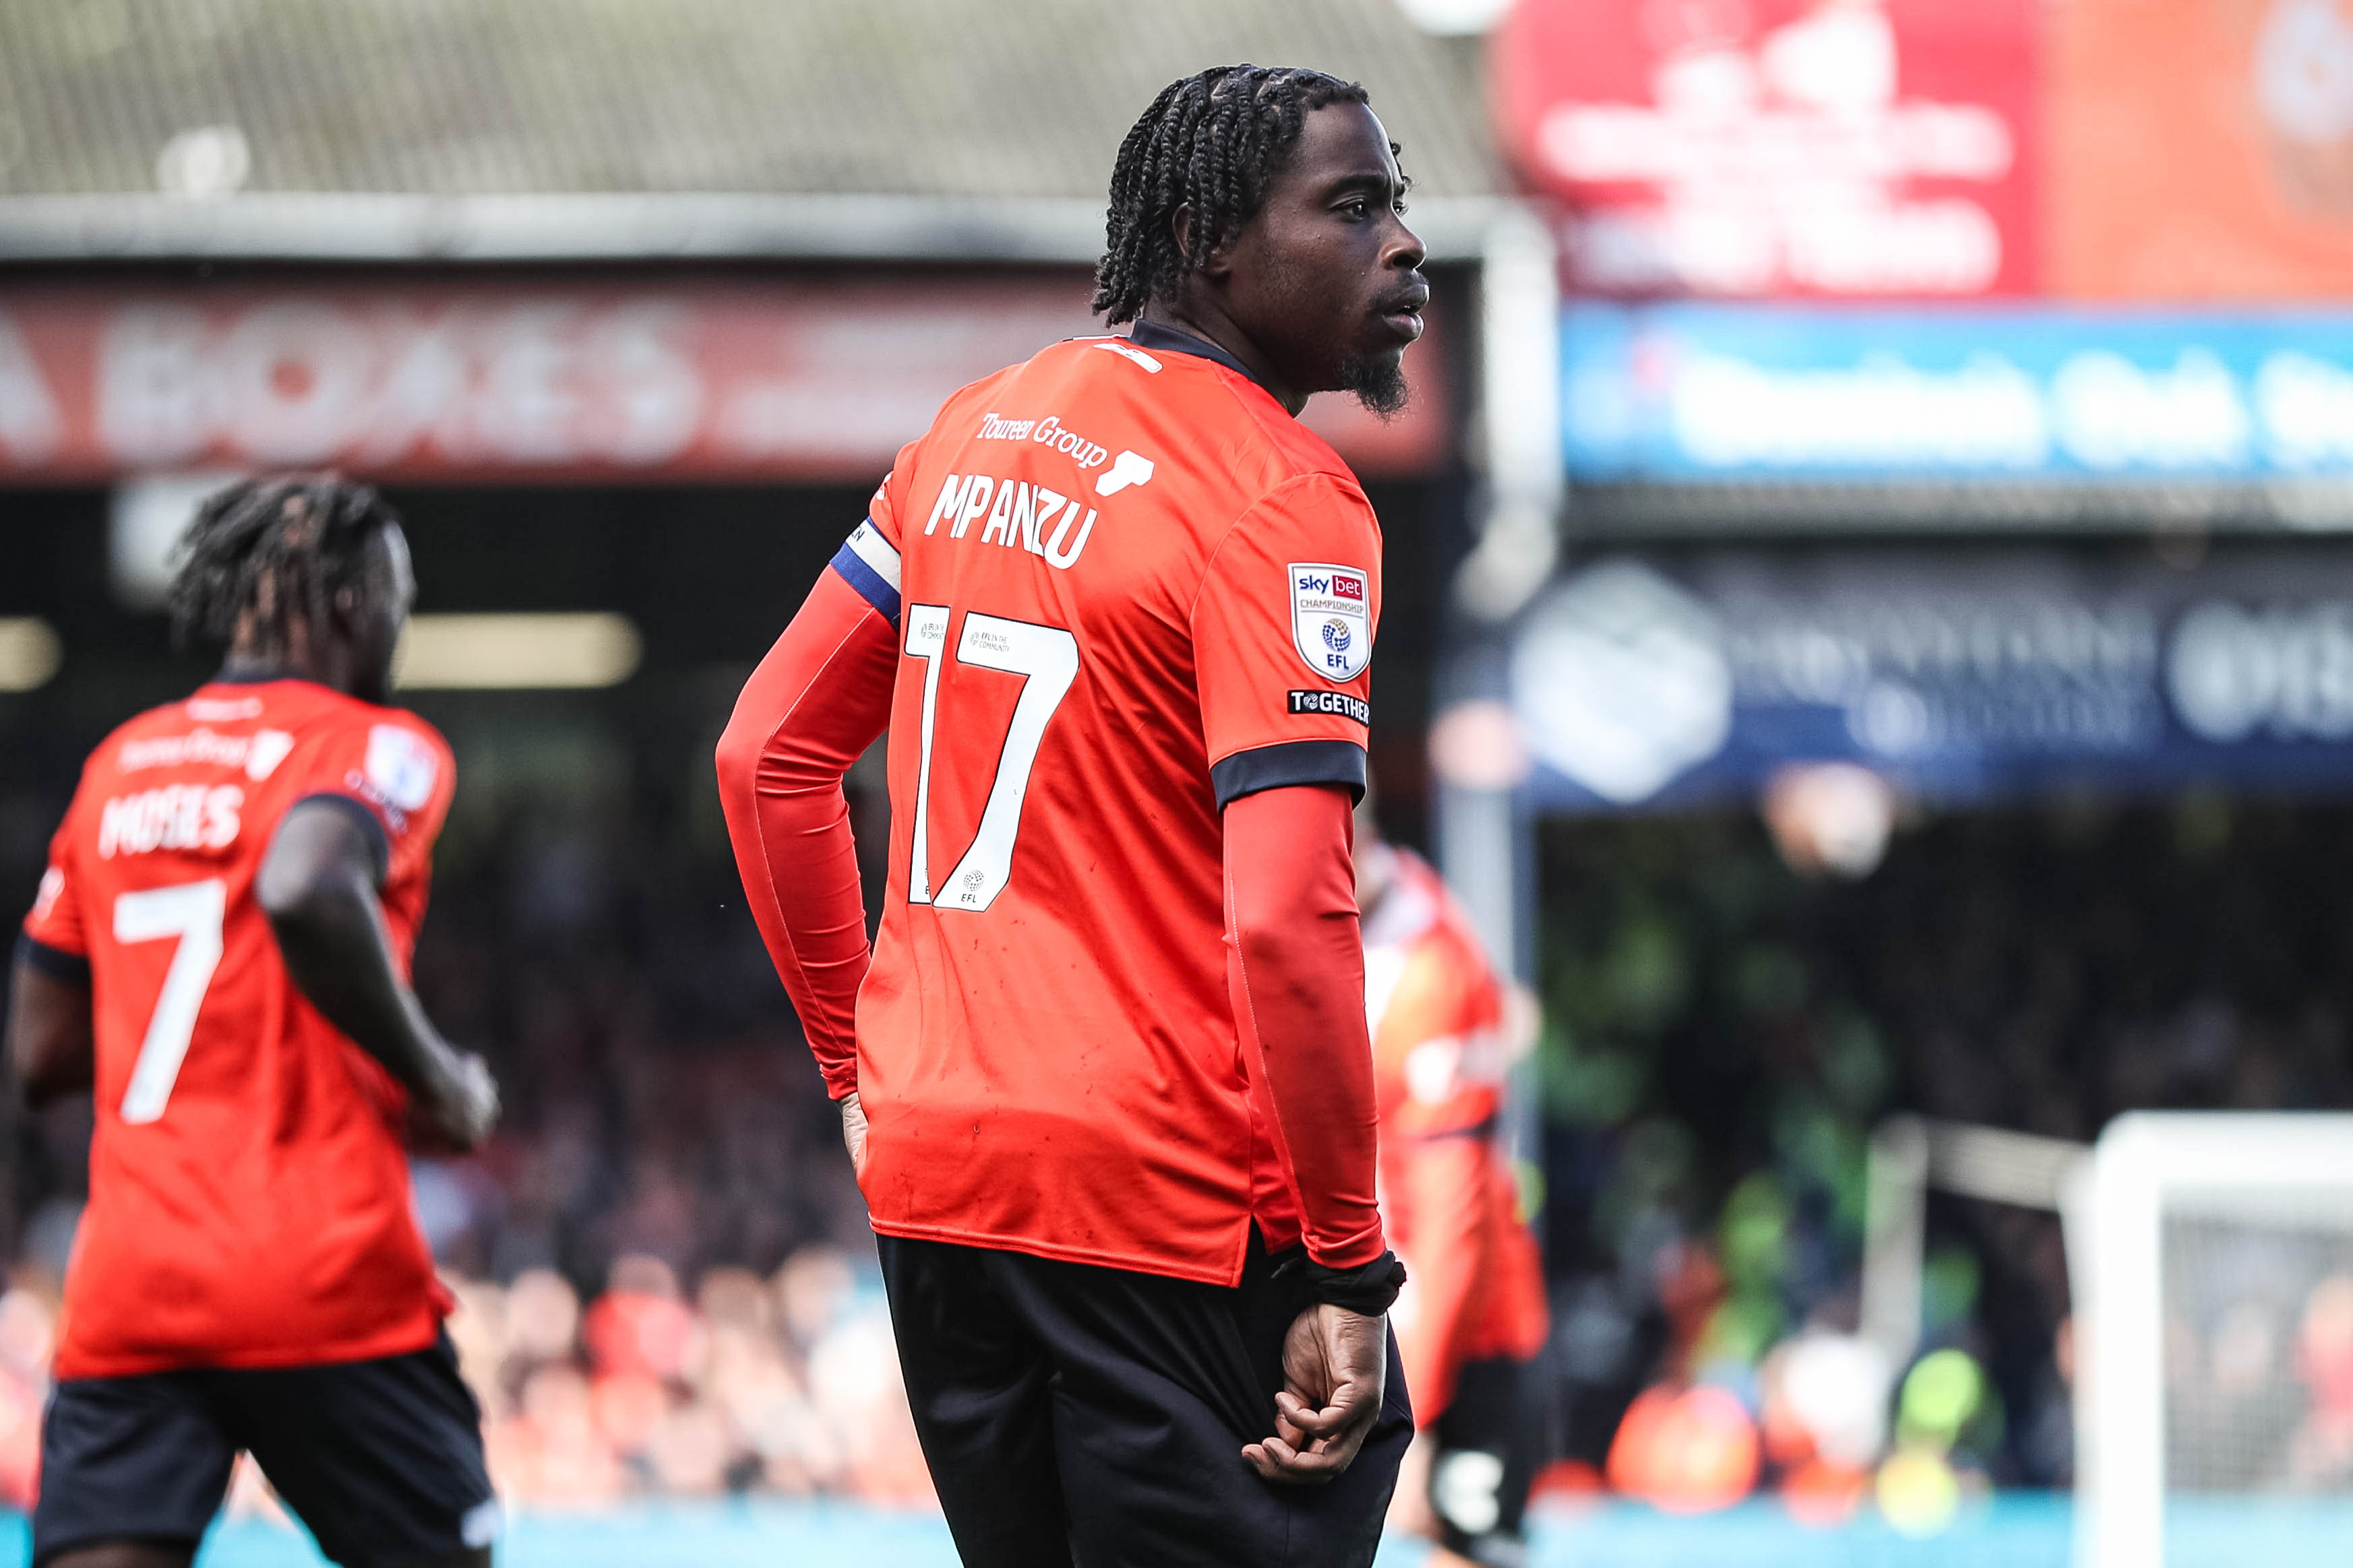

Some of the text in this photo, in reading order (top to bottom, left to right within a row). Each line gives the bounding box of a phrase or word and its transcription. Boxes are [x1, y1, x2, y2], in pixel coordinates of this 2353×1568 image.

[977, 413, 1109, 469] Toureen Group
[923, 474, 1098, 569] MPANZU
[1300, 574, 1361, 596] sky bet
[1300, 598, 1364, 614] CHAMPIONSHIP
[1327, 653, 1350, 670] EFL
[1291, 691, 1370, 725] TOGETHER
[904, 602, 1080, 912] 17
[98, 784, 245, 858] MOSES
[961, 893, 977, 904] EFL
[113, 877, 228, 1125] 7
